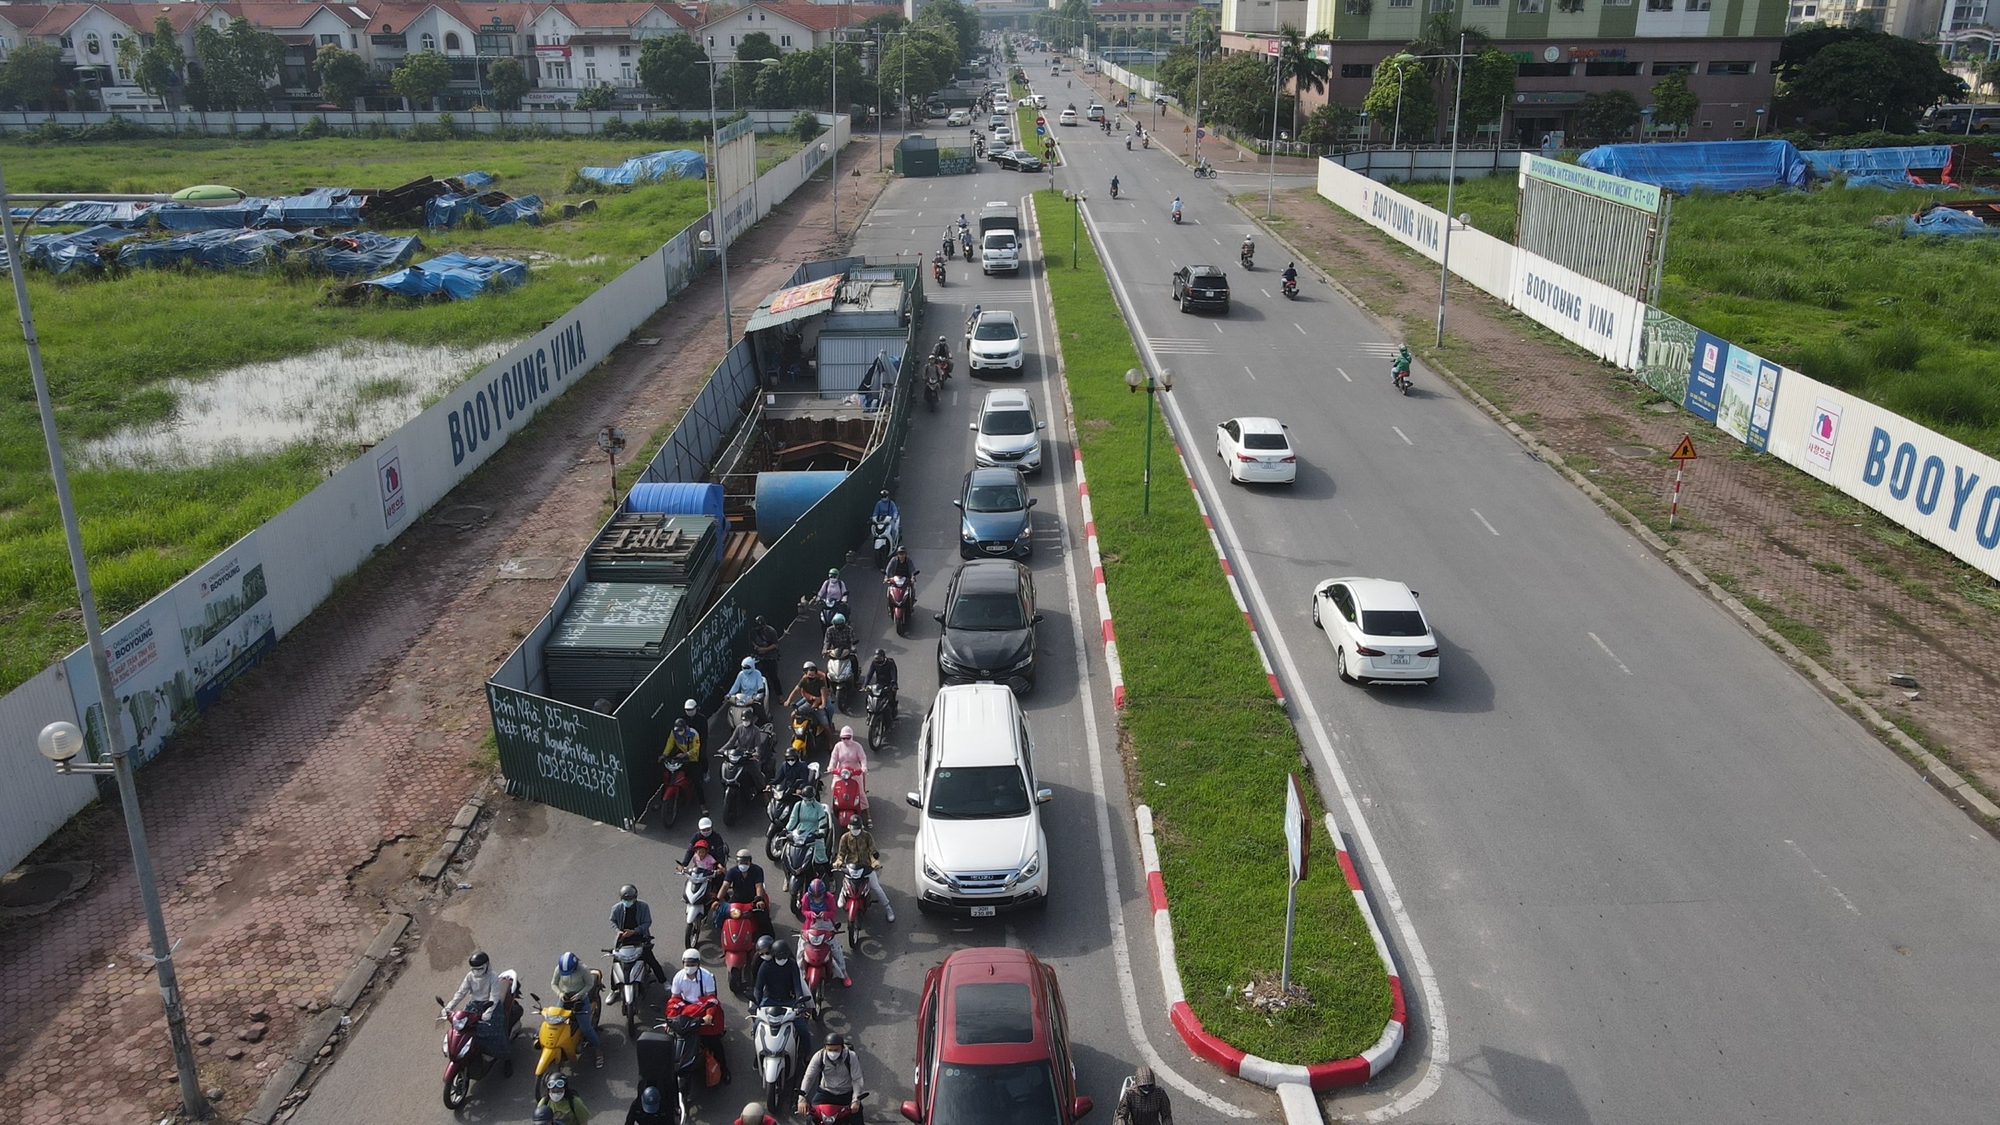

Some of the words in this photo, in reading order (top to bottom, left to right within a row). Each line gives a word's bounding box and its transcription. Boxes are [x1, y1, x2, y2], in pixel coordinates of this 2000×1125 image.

[1556, 166, 1596, 189] INTERNATIONAL
[1597, 179, 1632, 200] APARTMENT
[1372, 191, 1414, 238] BOOYOUNG
[1417, 212, 1439, 252] VINA
[1526, 272, 1582, 323] BOOYOUNG
[1588, 303, 1614, 340] VINA
[447, 348, 549, 467] BOOYOUNG
[550, 319, 587, 382] VINA
[1808, 442, 1832, 461] 사랑으로
[210, 565, 241, 592] BOOYOUNG
[115, 628, 153, 660] BOOYOUNG
